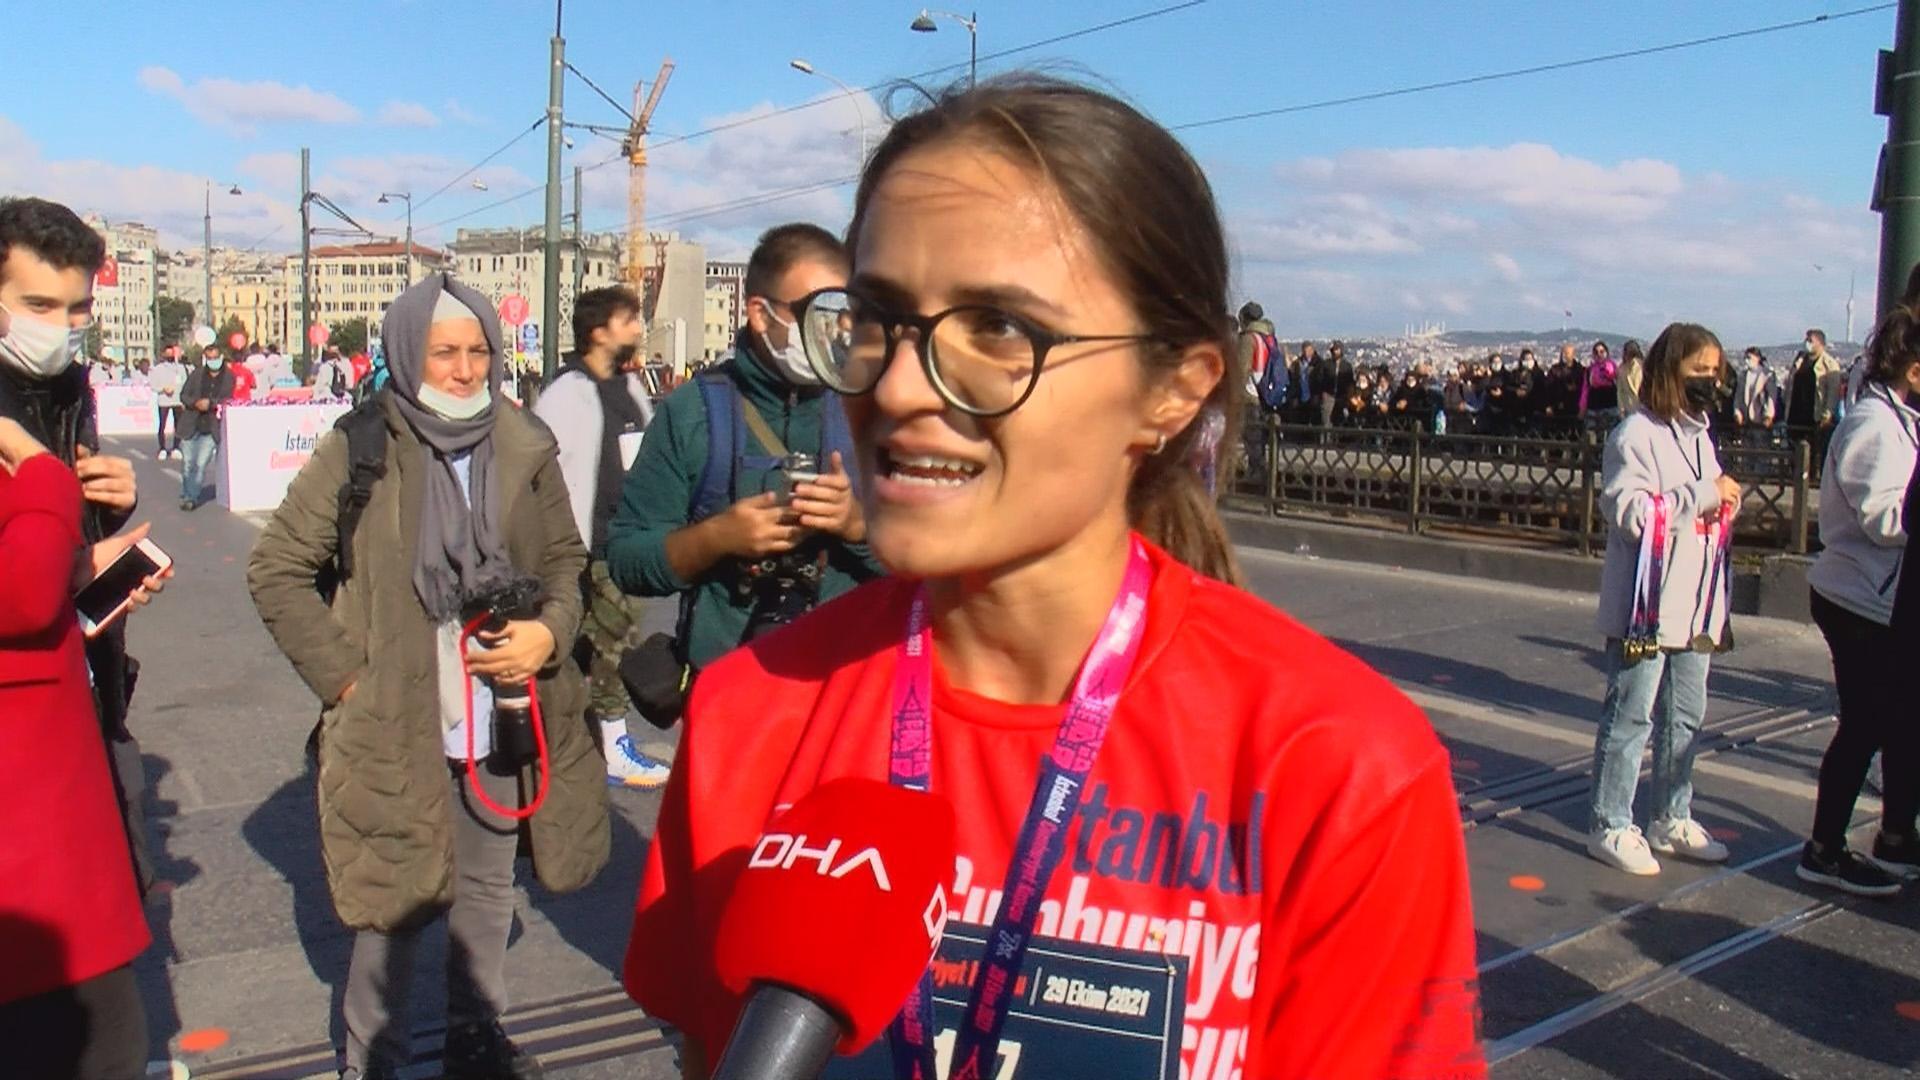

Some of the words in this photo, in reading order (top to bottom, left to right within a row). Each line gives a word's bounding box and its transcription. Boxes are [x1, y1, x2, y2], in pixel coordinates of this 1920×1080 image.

[748, 833, 892, 892] DHA
[1071, 782, 1266, 896] tanbul
[1042, 974, 1069, 1004] 29
[1067, 979, 1108, 1011] Ekim
[1106, 984, 1150, 1017] 2021
